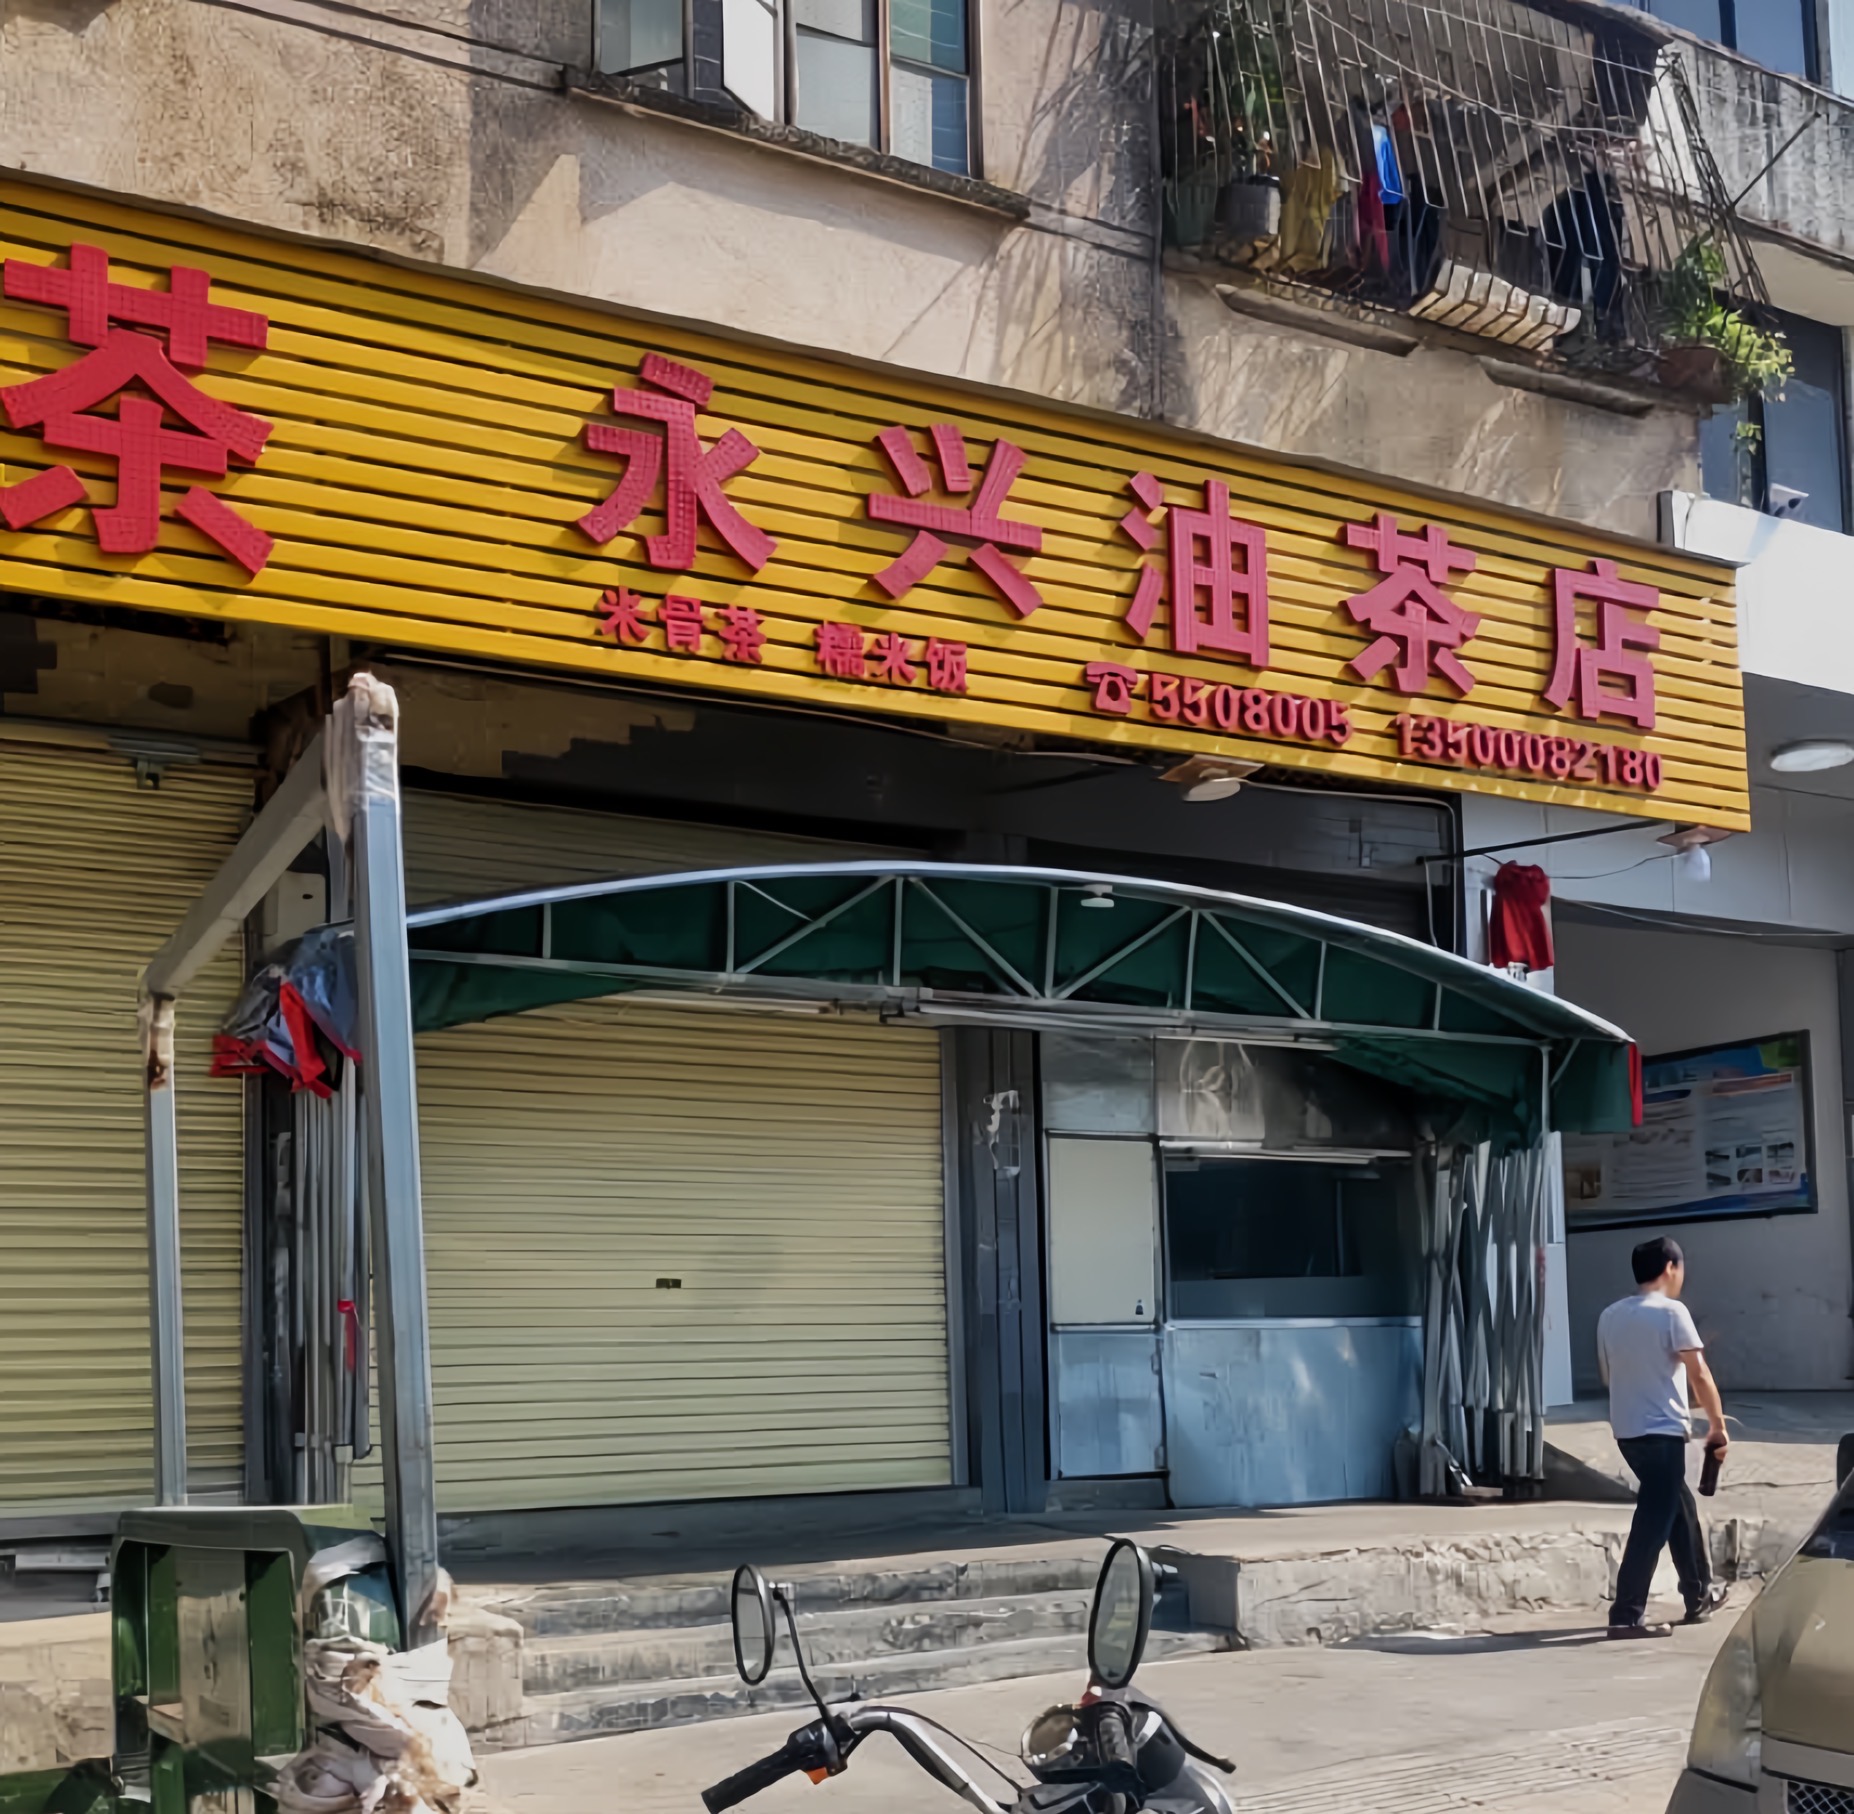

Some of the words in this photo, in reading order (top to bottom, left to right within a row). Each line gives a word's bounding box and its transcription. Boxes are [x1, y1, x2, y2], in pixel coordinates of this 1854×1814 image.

[1, 242, 275, 581] 茶
[577, 351, 1662, 731] 永兴油茶店
[599, 586, 768, 665] 米骨茶
[814, 620, 969, 695] 糯米饭
[1151, 672, 1353, 746] 5508005
[1396, 712, 1664, 793] 13500082180
